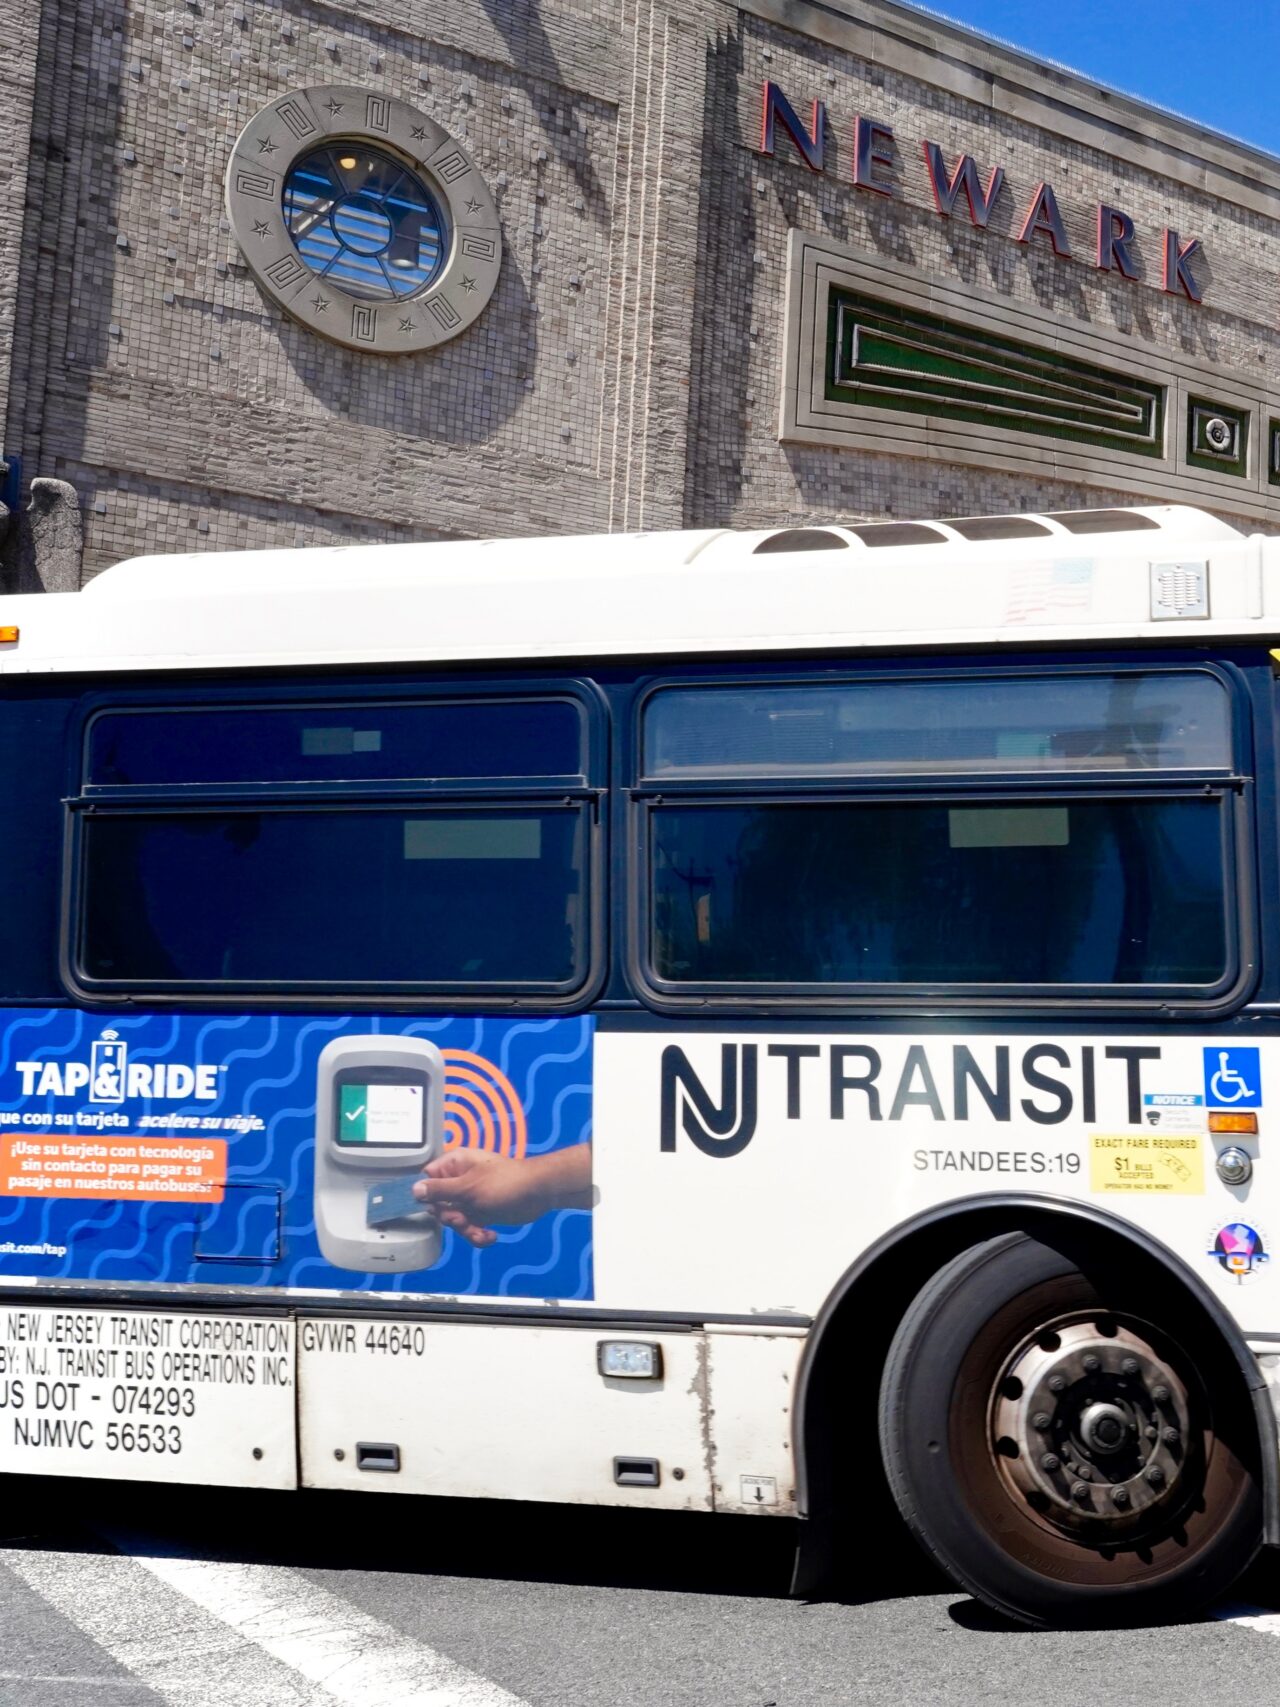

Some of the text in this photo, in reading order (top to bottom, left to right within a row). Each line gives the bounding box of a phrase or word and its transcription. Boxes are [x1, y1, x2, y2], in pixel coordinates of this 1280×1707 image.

[760, 79, 1202, 302] NEWARK
[659, 1043, 1162, 1158] NJ TRANSIT
[1152, 1095, 1196, 1105] NOTICE
[0, 1112, 266, 1133] ue con su tarjeta acelere su viaje.
[11, 1142, 214, 1162] ¡Use su tarjeta con tecnología
[1095, 1139, 1197, 1149] EXACT FARE REQUIRED
[21, 1159, 202, 1181] sin contacto para pagar su
[913, 1149, 1081, 1174] STANDEES:19
[1114, 1157, 1129, 1171] $1
[8, 1175, 213, 1193] pasaje en nuestros autobuses!
[7, 1313, 289, 1353] NEW JERSEY TRANSIT CORPORATION
[302, 1322, 425, 1356] GVWR 44640
[25, 1347, 51, 1376] N.J.
[57, 1348, 118, 1379] TRANSIT
[125, 1351, 154, 1380] BUS
[162, 1352, 256, 1386] OPERATIONS
[263, 1357, 292, 1387] INC.
[36, 1381, 80, 1411] DOT
[112, 1385, 196, 1418] 074293
[14, 1418, 182, 1455] NJMVC 56533
